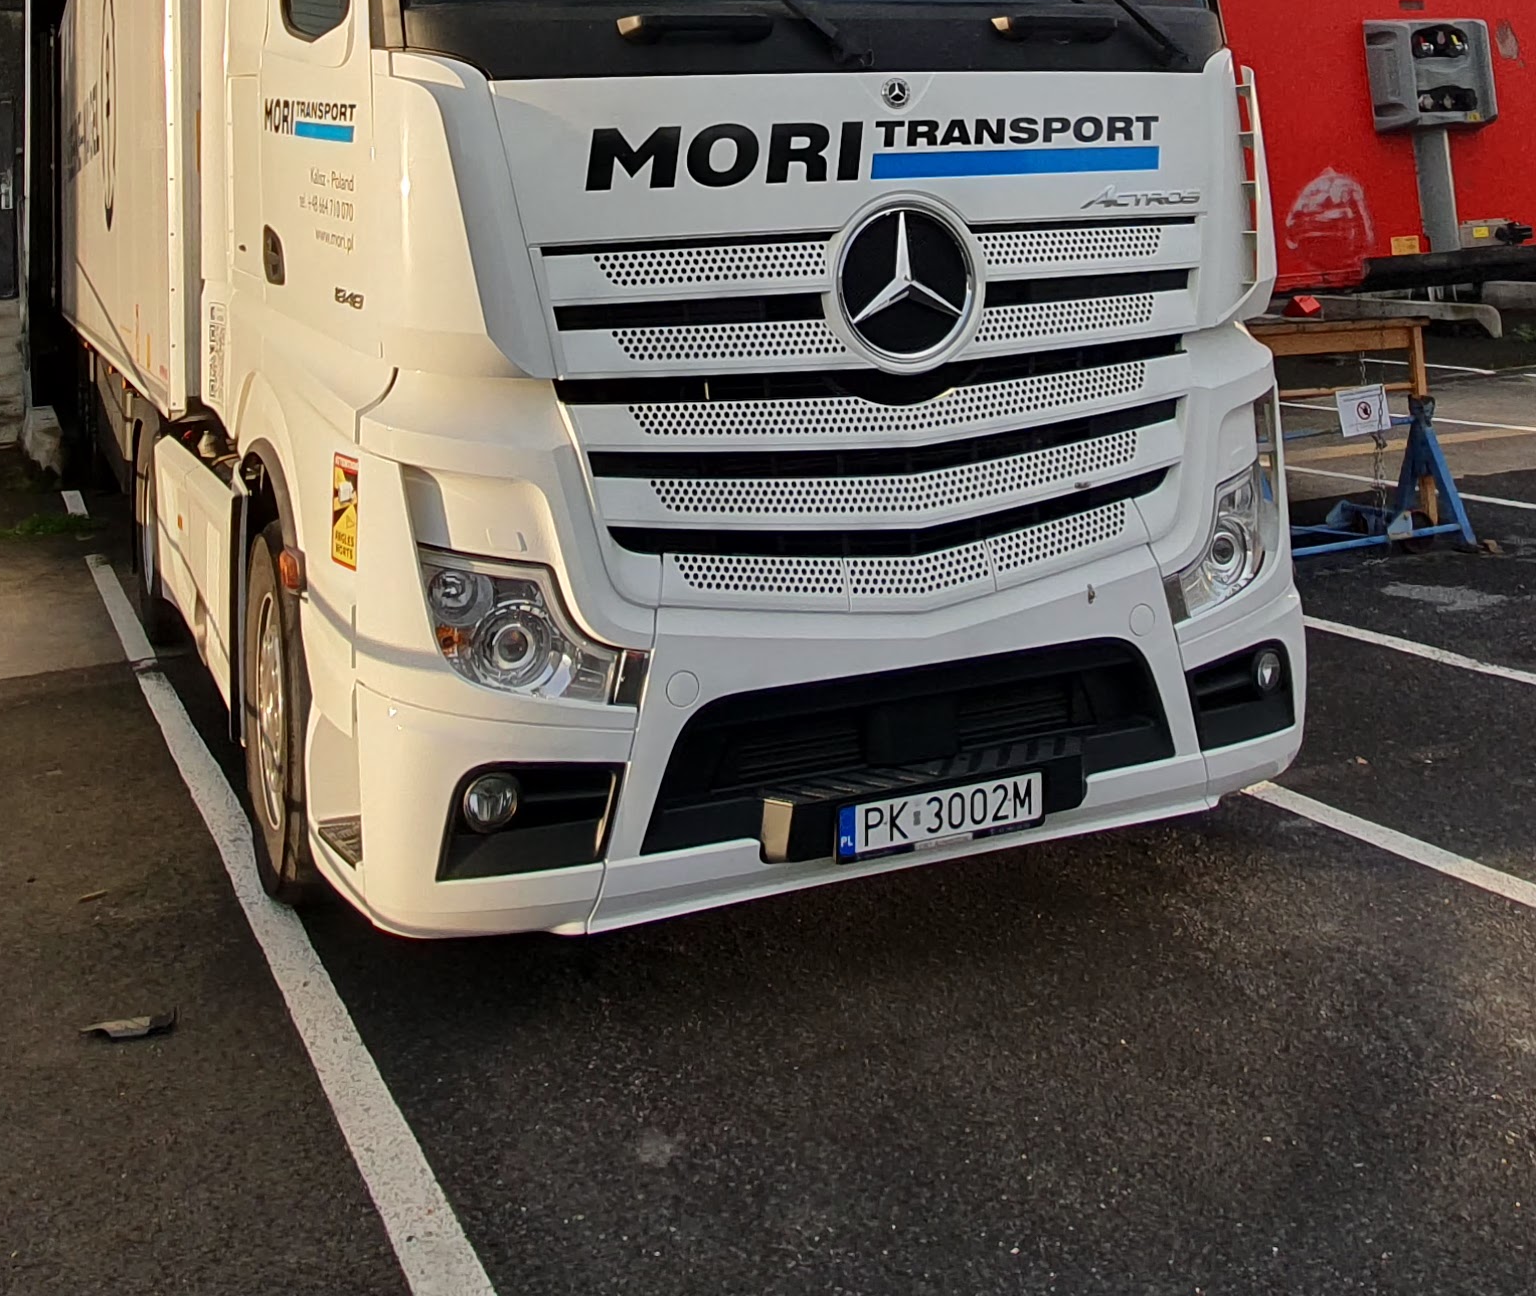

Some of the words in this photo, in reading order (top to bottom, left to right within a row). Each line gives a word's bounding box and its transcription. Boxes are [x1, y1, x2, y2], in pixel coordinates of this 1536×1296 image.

[264, 98, 294, 135] MORI
[296, 100, 356, 122] TRANSPORT
[584, 121, 864, 191] MORI
[875, 116, 1160, 148] TRANSPORT
[331, 170, 353, 191] Poland
[342, 201, 353, 221] 070
[864, 801, 909, 847] PK
[926, 778, 1032, 833] 3002M
[840, 835, 853, 847] PL
